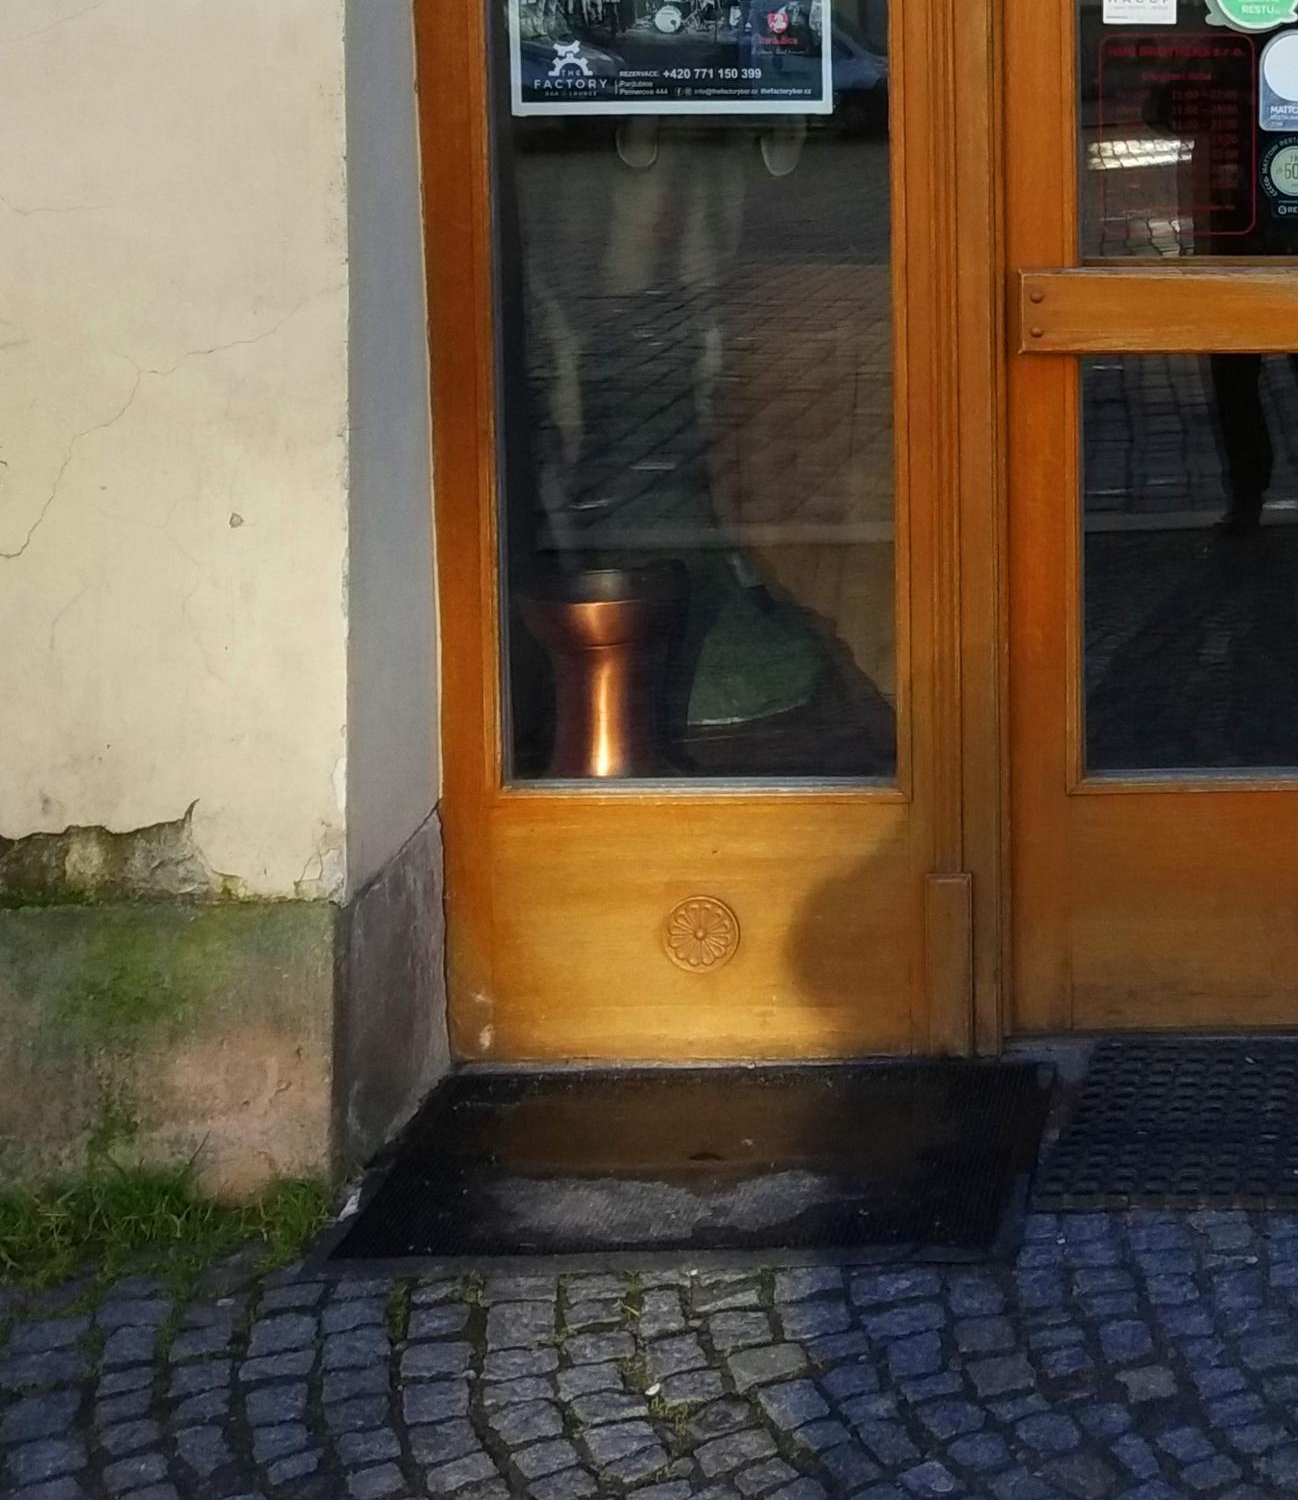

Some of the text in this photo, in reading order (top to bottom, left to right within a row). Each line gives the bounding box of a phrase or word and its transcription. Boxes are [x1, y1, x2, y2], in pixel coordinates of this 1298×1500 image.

[663, 69, 691, 79] +420
[694, 69, 713, 79] 771
[718, 68, 738, 79] 150
[741, 68, 762, 79] 399
[533, 79, 608, 90] FACTORY
